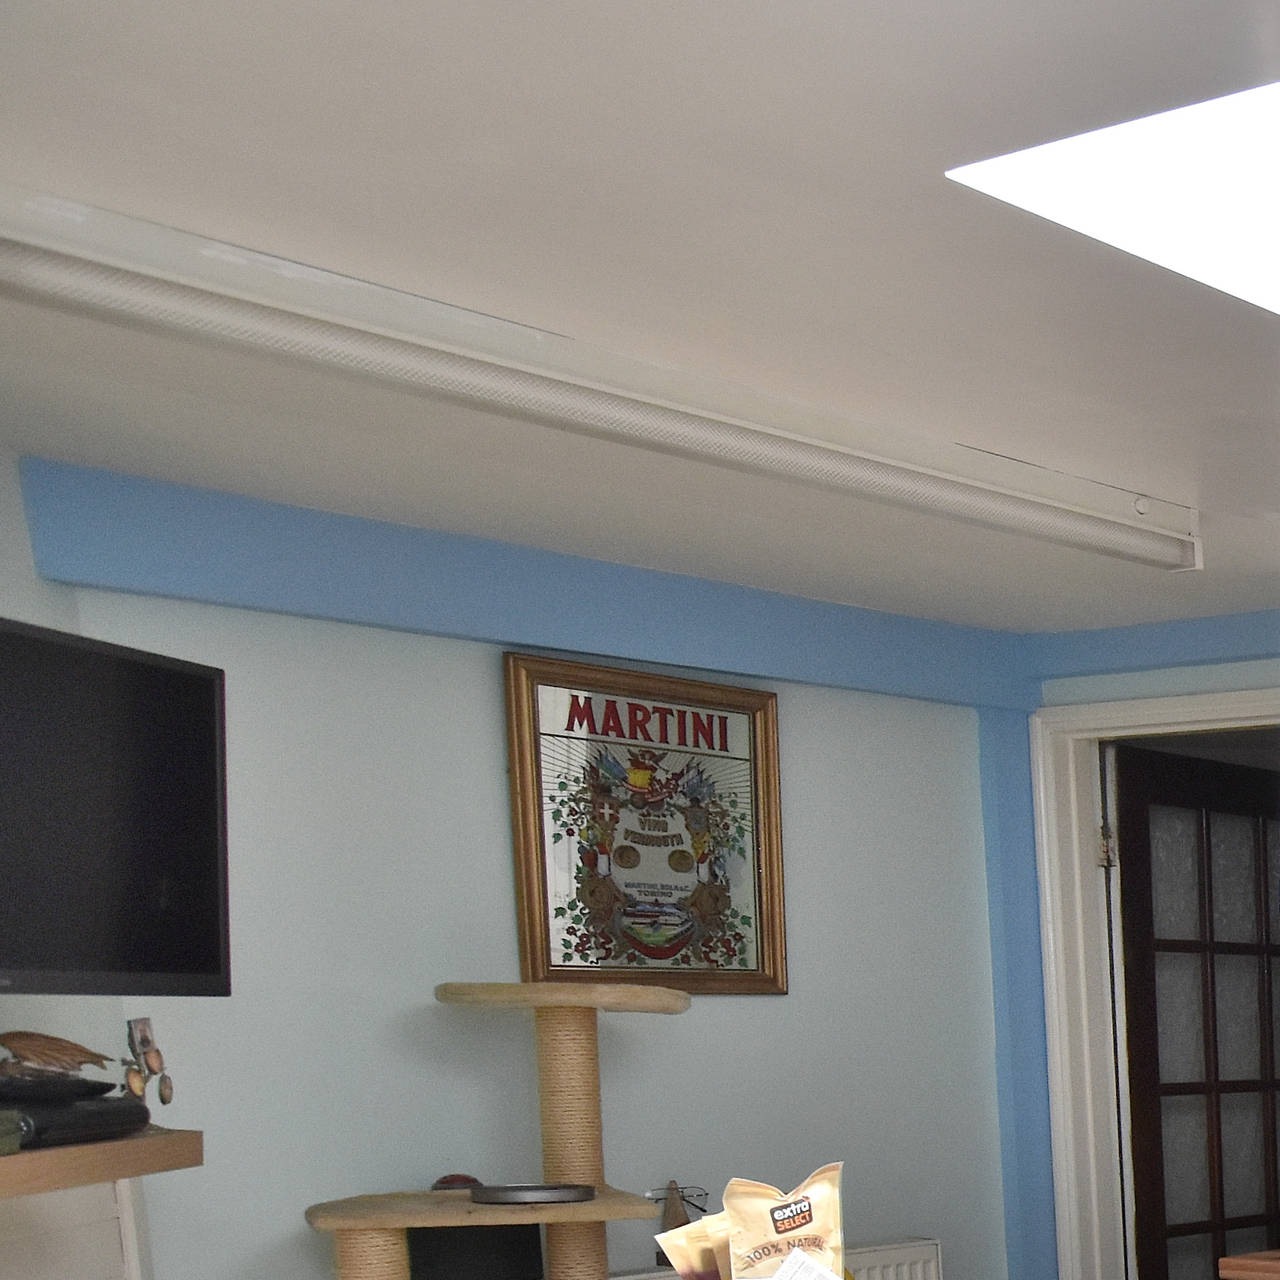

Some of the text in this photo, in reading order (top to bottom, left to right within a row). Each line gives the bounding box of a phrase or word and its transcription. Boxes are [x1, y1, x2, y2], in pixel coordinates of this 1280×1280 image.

[565, 694, 729, 752] MARTINI
[773, 1200, 811, 1221] extra
[776, 1211, 811, 1232] SELECT
[746, 1242, 783, 1264] 100%
